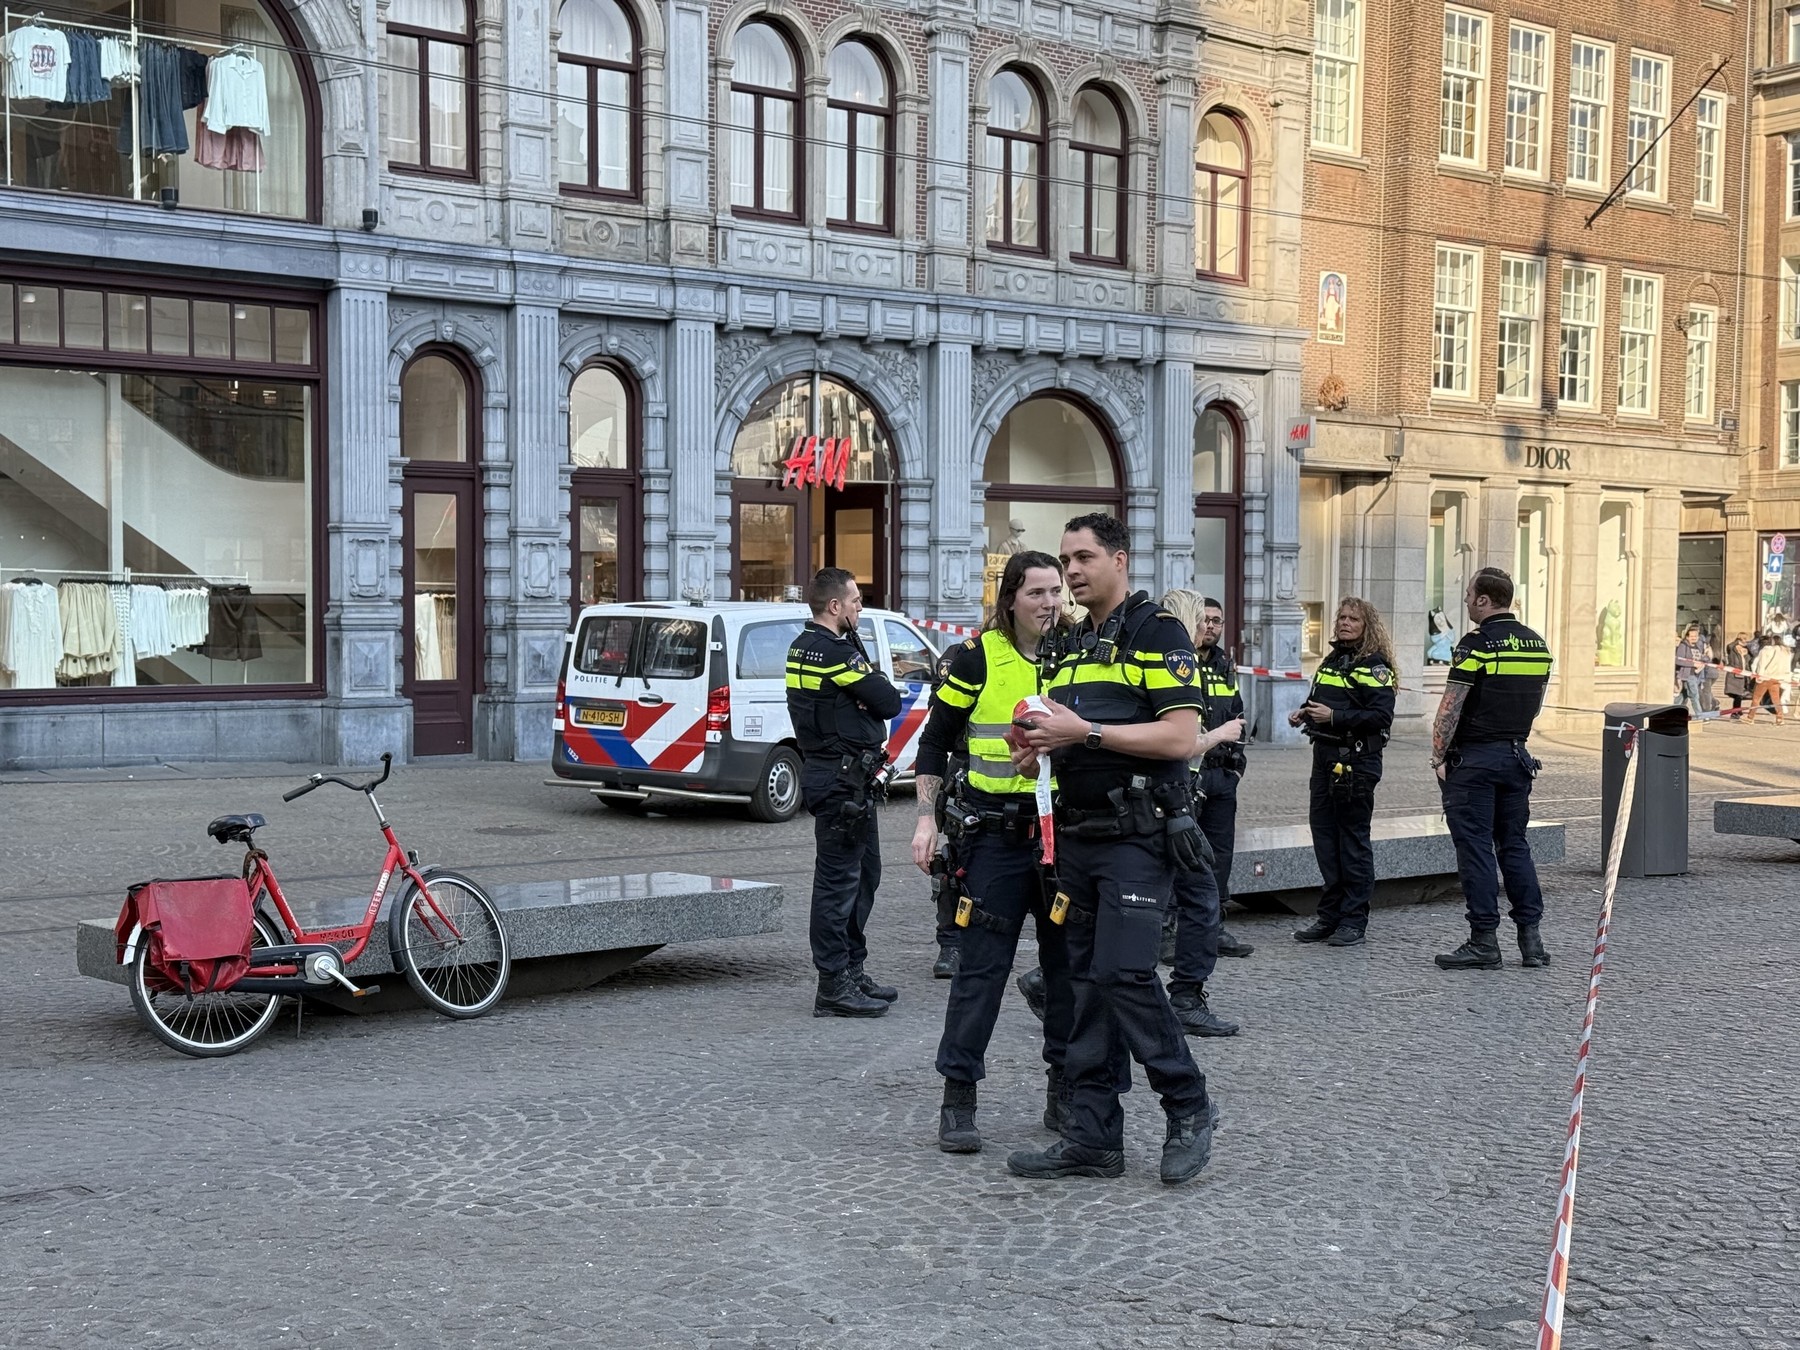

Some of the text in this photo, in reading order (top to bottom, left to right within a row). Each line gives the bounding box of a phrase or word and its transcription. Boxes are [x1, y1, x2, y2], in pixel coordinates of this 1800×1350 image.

[781, 435, 852, 492] H&M
[1524, 445, 1571, 471] DIOR
[574, 674, 608, 684] POLITIE
[582, 710, 620, 723] N-410-SH
